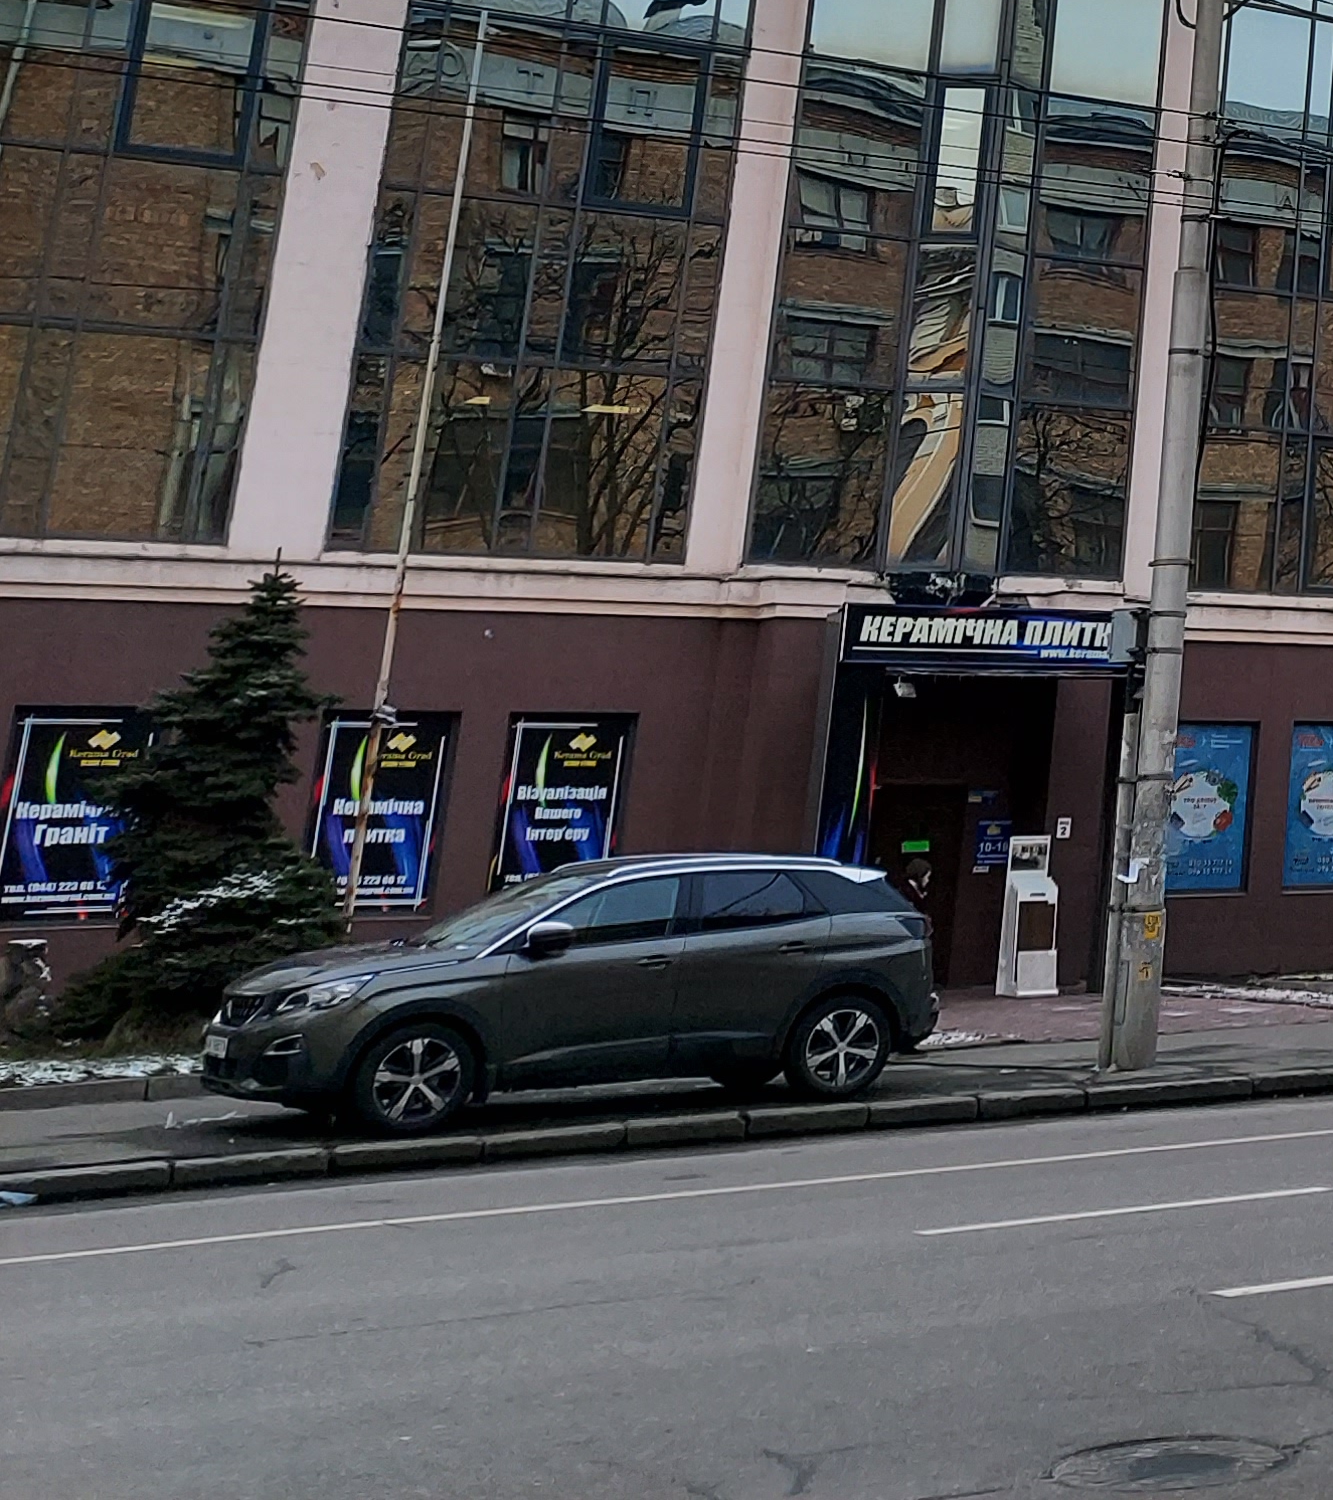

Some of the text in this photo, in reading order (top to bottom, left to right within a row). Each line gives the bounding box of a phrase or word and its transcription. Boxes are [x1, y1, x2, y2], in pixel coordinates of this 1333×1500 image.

[859, 615, 1111, 648] КЕРАМІЧНА ПЛИТК
[33, 823, 109, 847] Граніт
[343, 828, 406, 844] питка
[1060, 826, 1067, 836] 2
